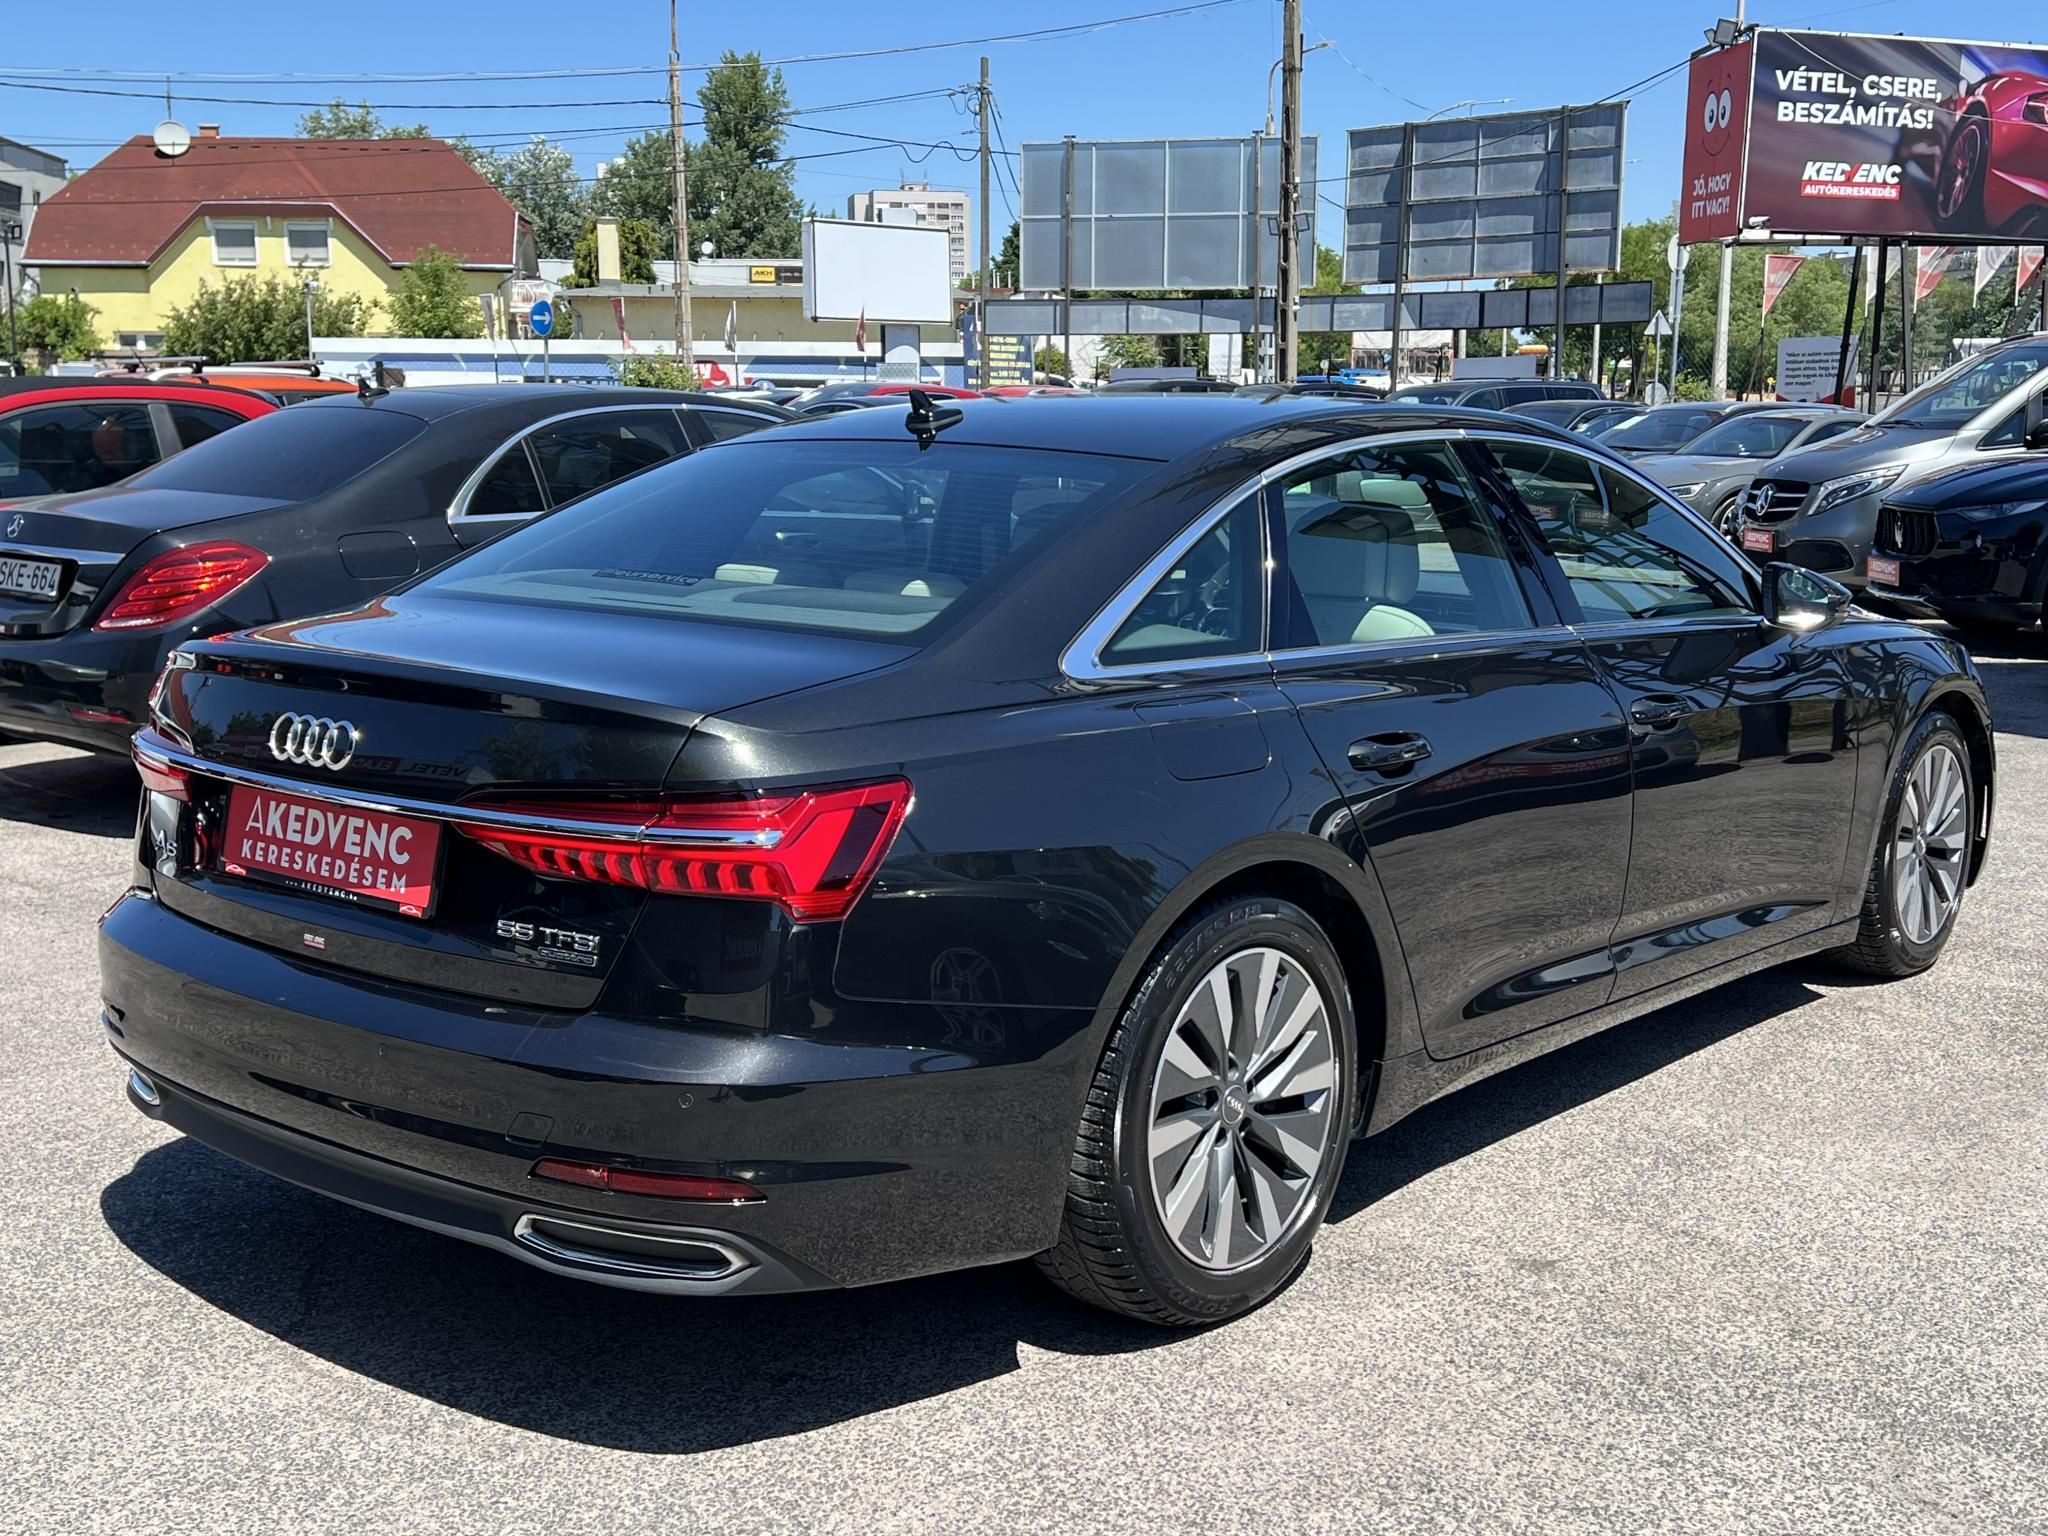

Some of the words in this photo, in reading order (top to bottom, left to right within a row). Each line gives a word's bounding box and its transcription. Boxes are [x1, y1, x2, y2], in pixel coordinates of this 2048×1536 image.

[1775, 66, 1857, 98] VÉTEL,
[1863, 75, 1943, 103] CSERE,
[1777, 99, 1934, 130] BESZÁMÍTÁS!
[1693, 174, 1706, 197] JÓ,
[1708, 172, 1732, 194] HOGY
[1802, 160, 1903, 184] KEDVENC
[1804, 185, 1898, 198] AUTÓKERESKEDÉS
[1691, 201, 1705, 219] ITT
[1706, 196, 1730, 216] VAGY!
[0, 560, 58, 592] SKE-664
[155, 829, 178, 857] A6
[241, 838, 407, 895] KERESKEDÉSEM
[496, 919, 534, 942] 55
[539, 926, 600, 954] TFSI
